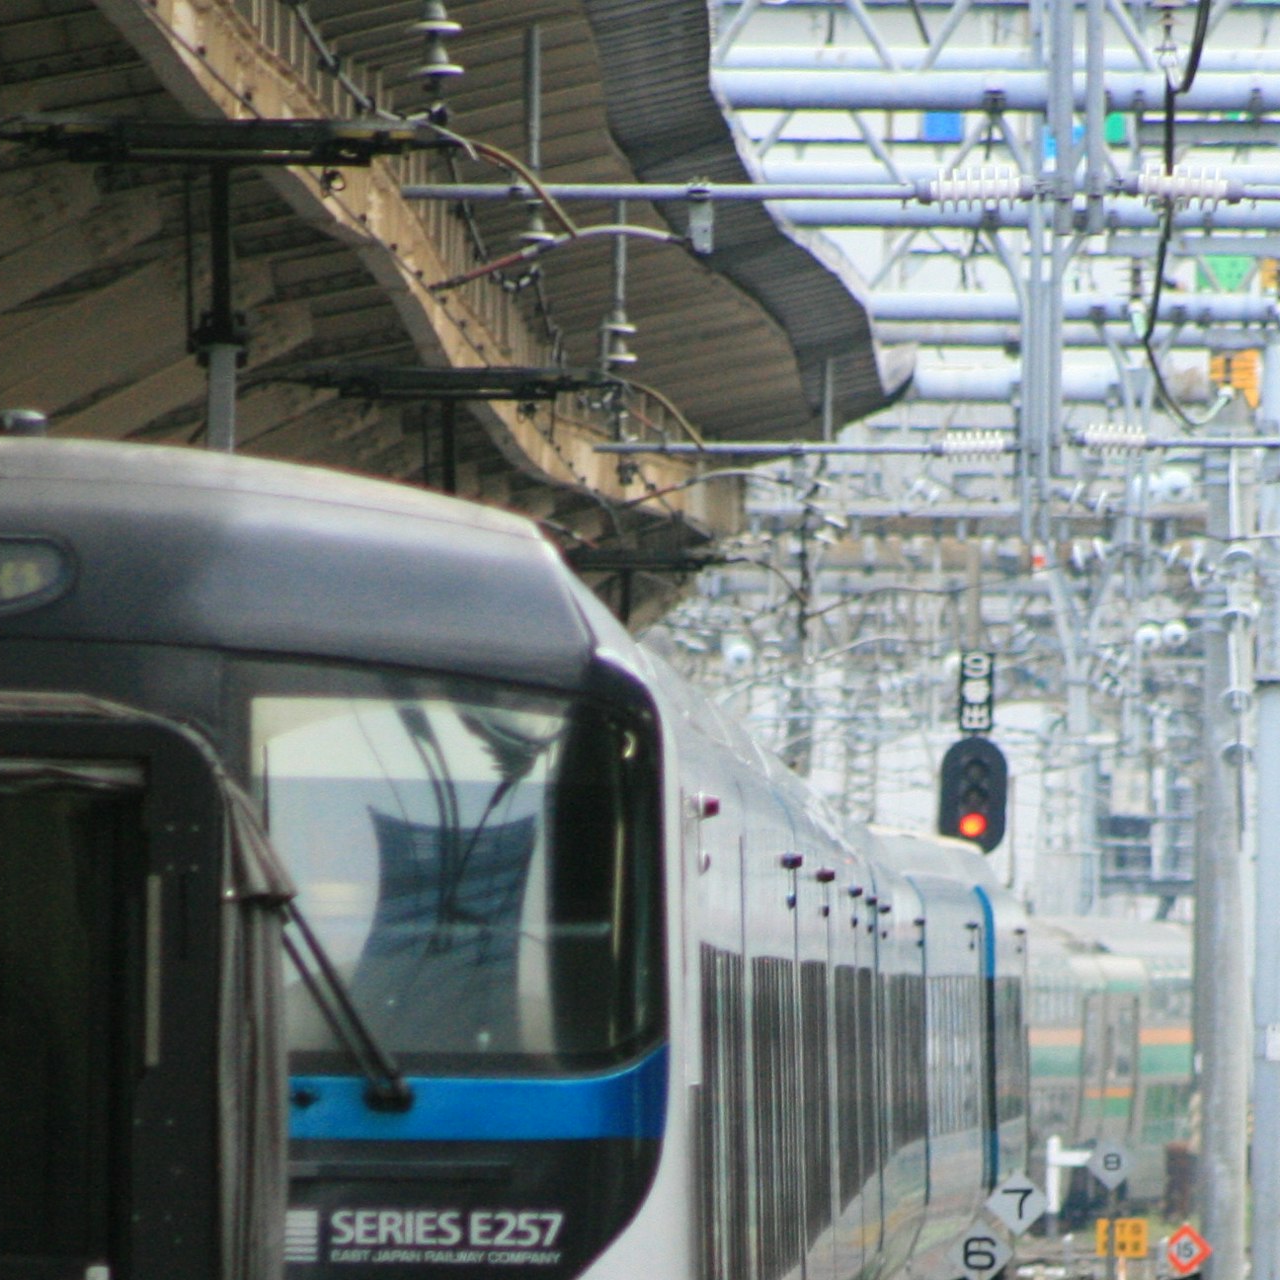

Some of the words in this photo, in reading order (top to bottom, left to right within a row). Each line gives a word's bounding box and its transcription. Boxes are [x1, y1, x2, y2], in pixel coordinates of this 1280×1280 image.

[1103, 1154, 1122, 1171] 8
[1001, 1188, 1034, 1220] 7
[331, 1209, 461, 1246] SERIES
[470, 1211, 564, 1248] E257
[330, 1248, 369, 1264] EAST
[372, 1249, 421, 1264] JAPAN
[424, 1250, 483, 1265] RAILWAY
[487, 1250, 562, 1265] COMPANY
[962, 1236, 998, 1271] 6
